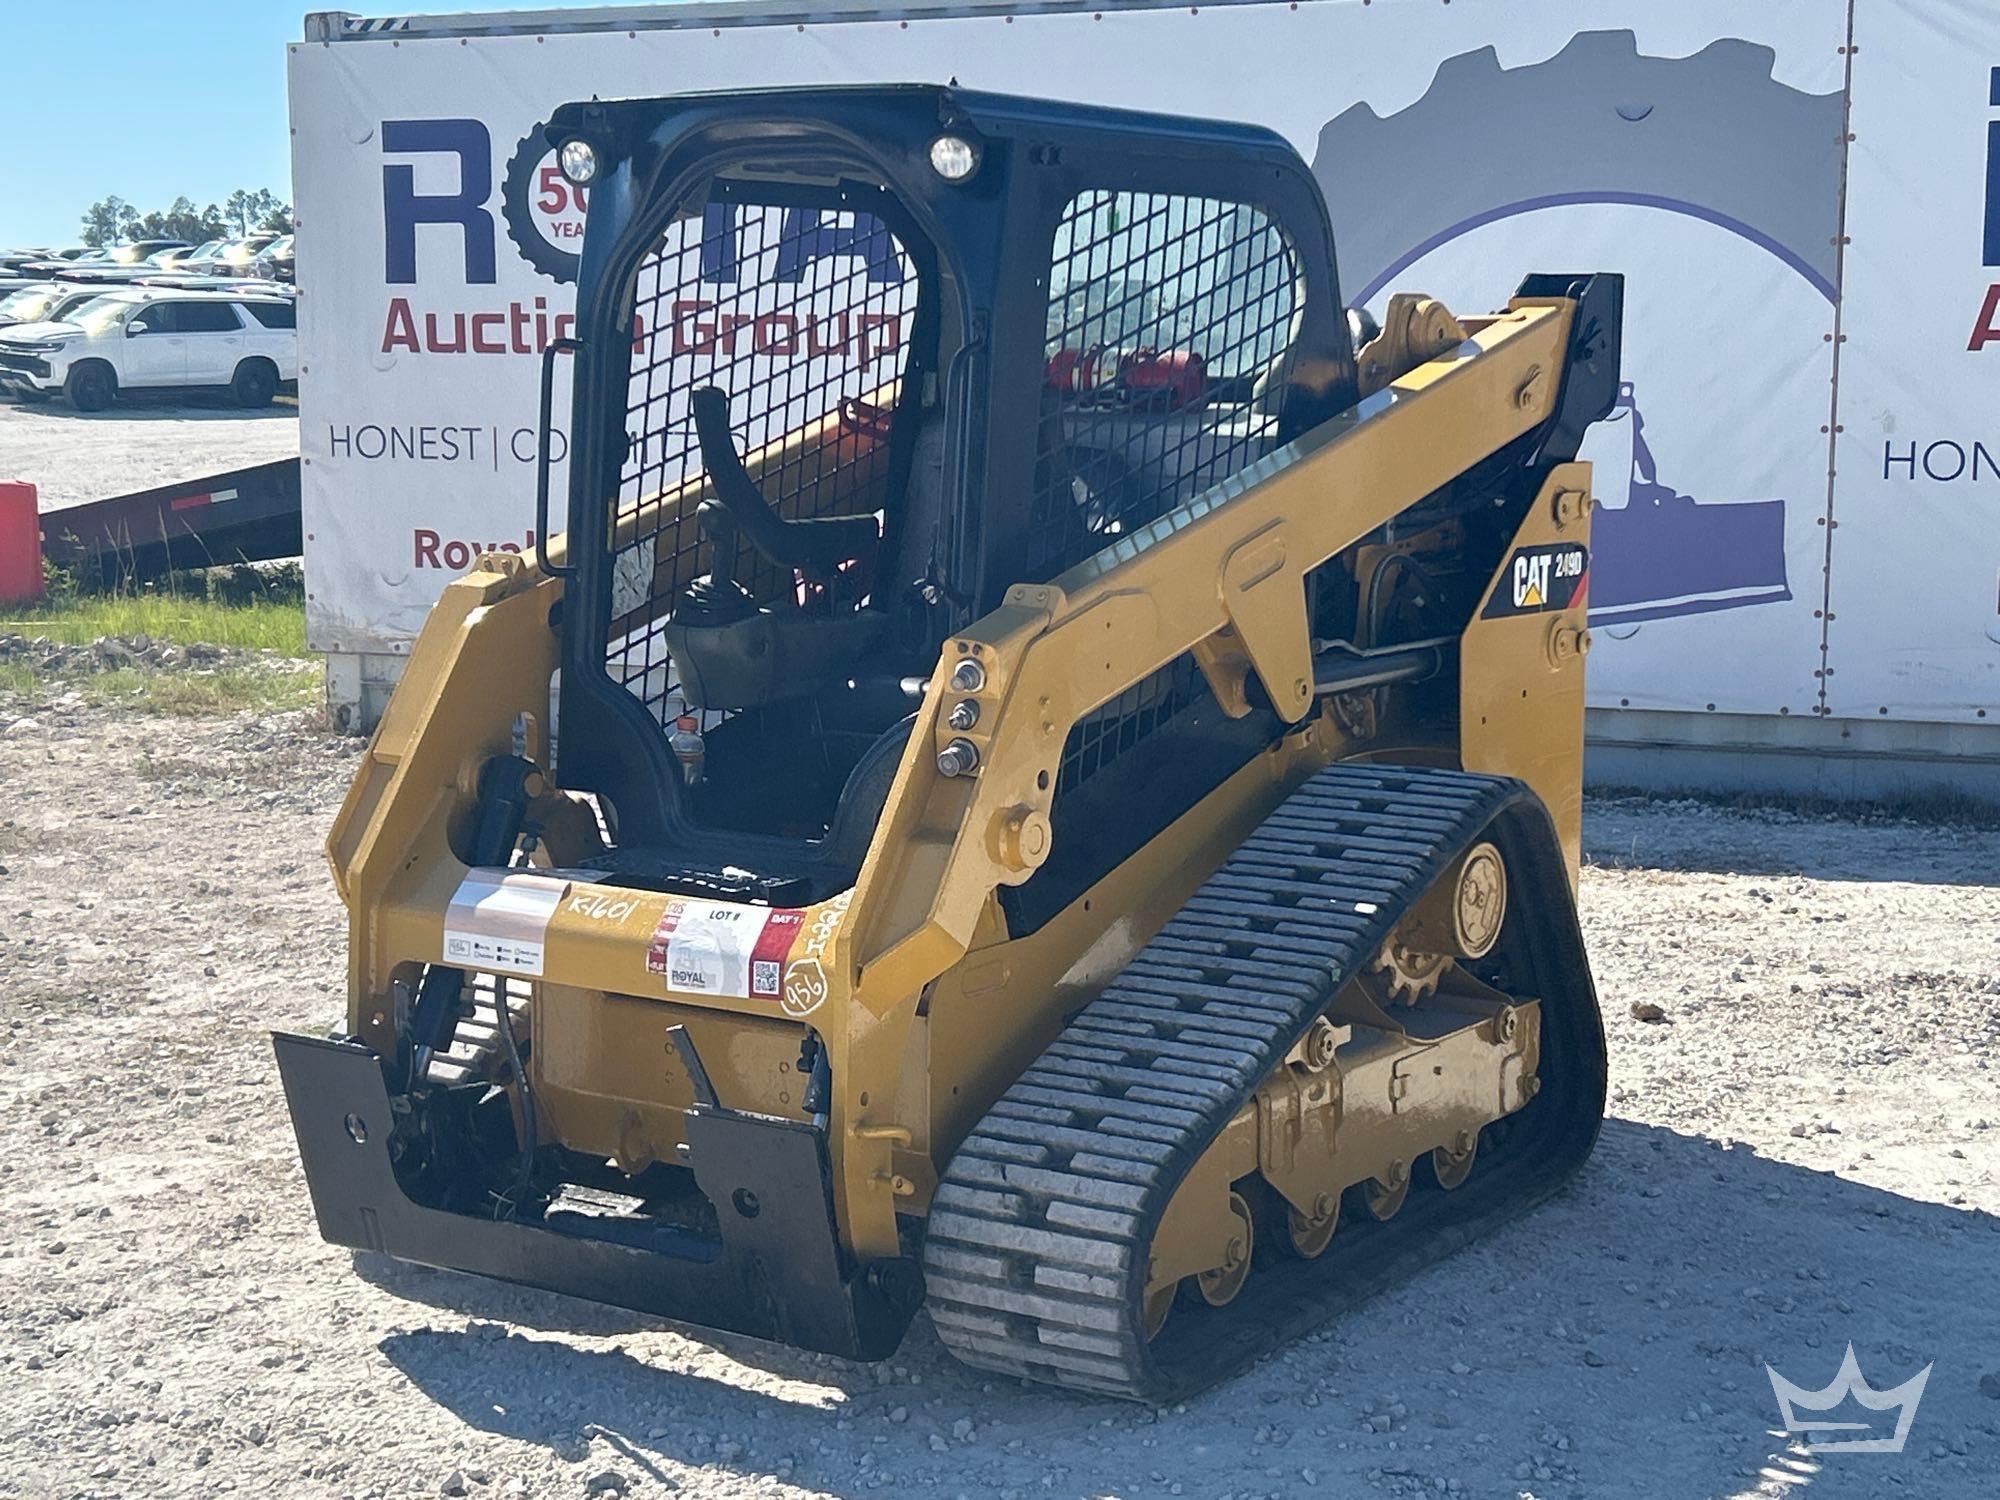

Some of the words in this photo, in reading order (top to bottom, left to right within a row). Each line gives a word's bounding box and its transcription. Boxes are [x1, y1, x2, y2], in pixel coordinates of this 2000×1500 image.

[672, 301, 899, 373] Group
[330, 424, 483, 461] HONEST
[1513, 553, 1552, 608] CAT
[1554, 550, 1582, 578] 249D
[709, 909, 732, 921] LOT
[671, 969, 706, 984] ROYAL
[786, 973, 823, 1011] 956
